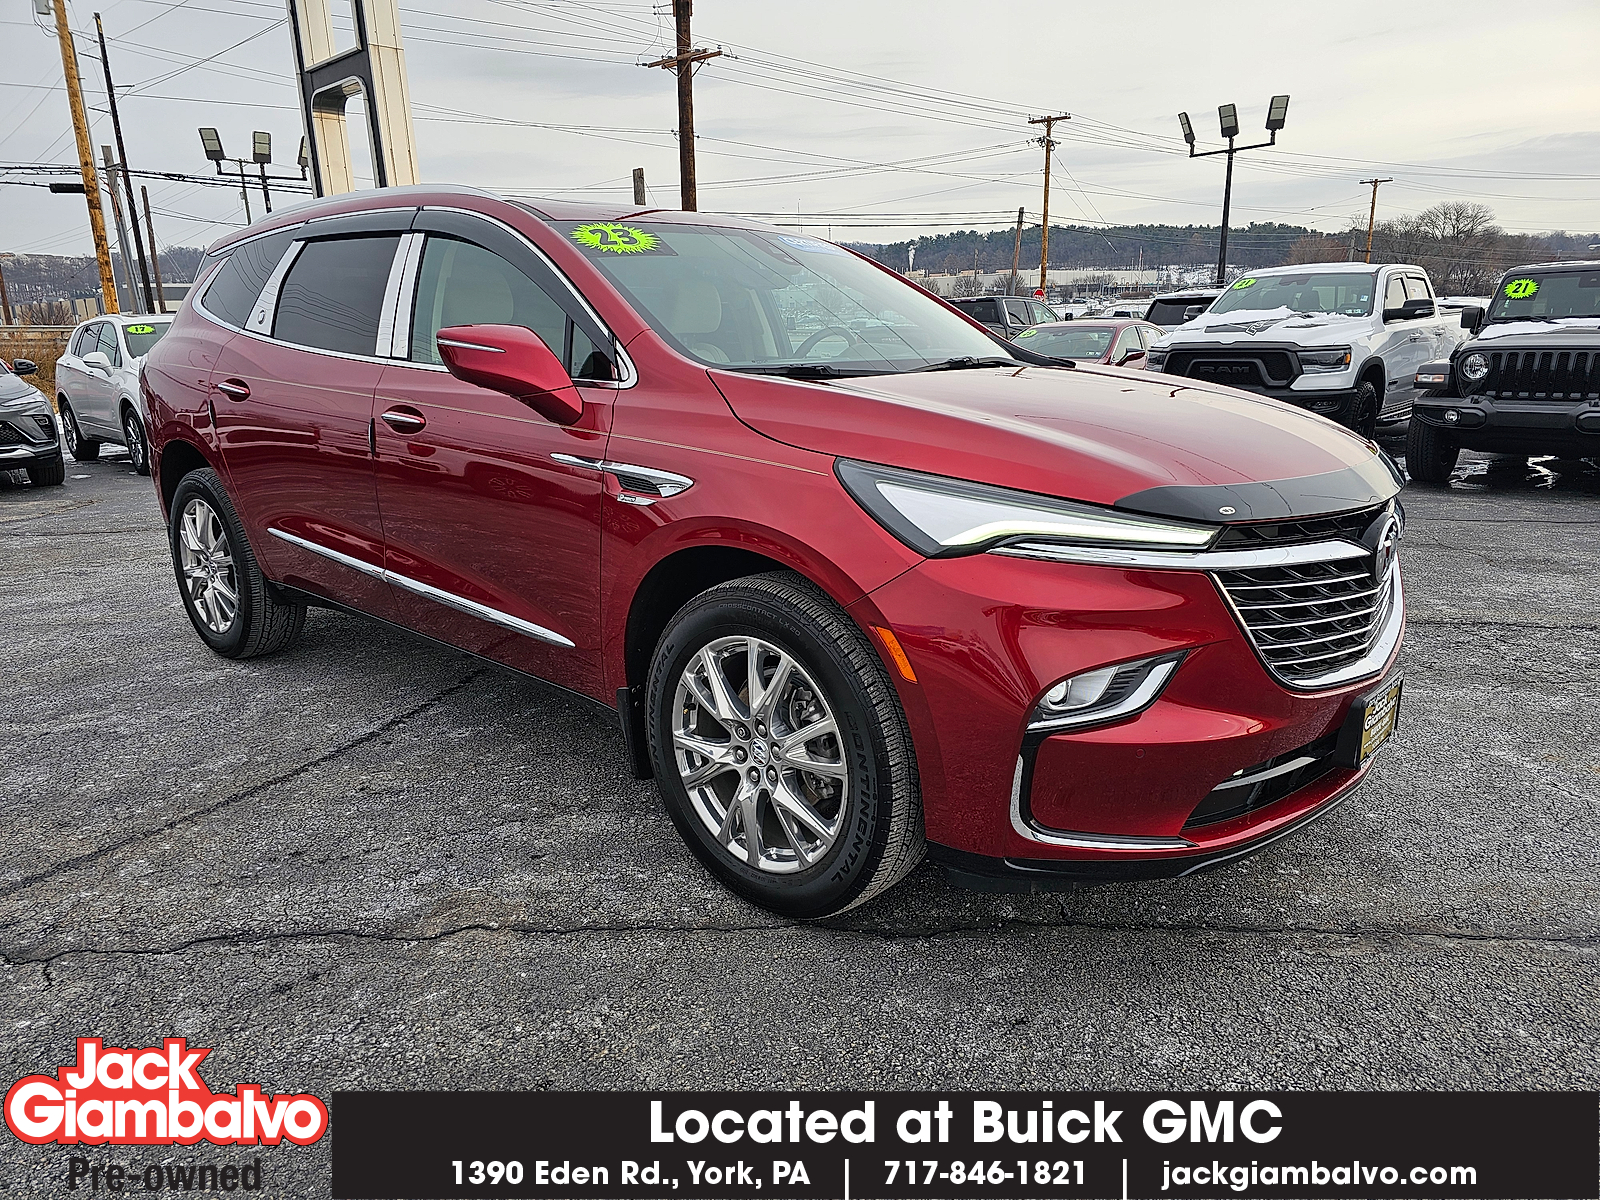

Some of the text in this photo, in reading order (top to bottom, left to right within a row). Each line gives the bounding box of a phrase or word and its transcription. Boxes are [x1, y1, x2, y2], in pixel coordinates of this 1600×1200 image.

[588, 228, 638, 246] 23
[1512, 282, 1530, 294] 21
[1199, 366, 1250, 374] RAM
[778, 618, 790, 628] LX
[789, 627, 801, 637] 20
[830, 711, 870, 883] CONTINENTAL
